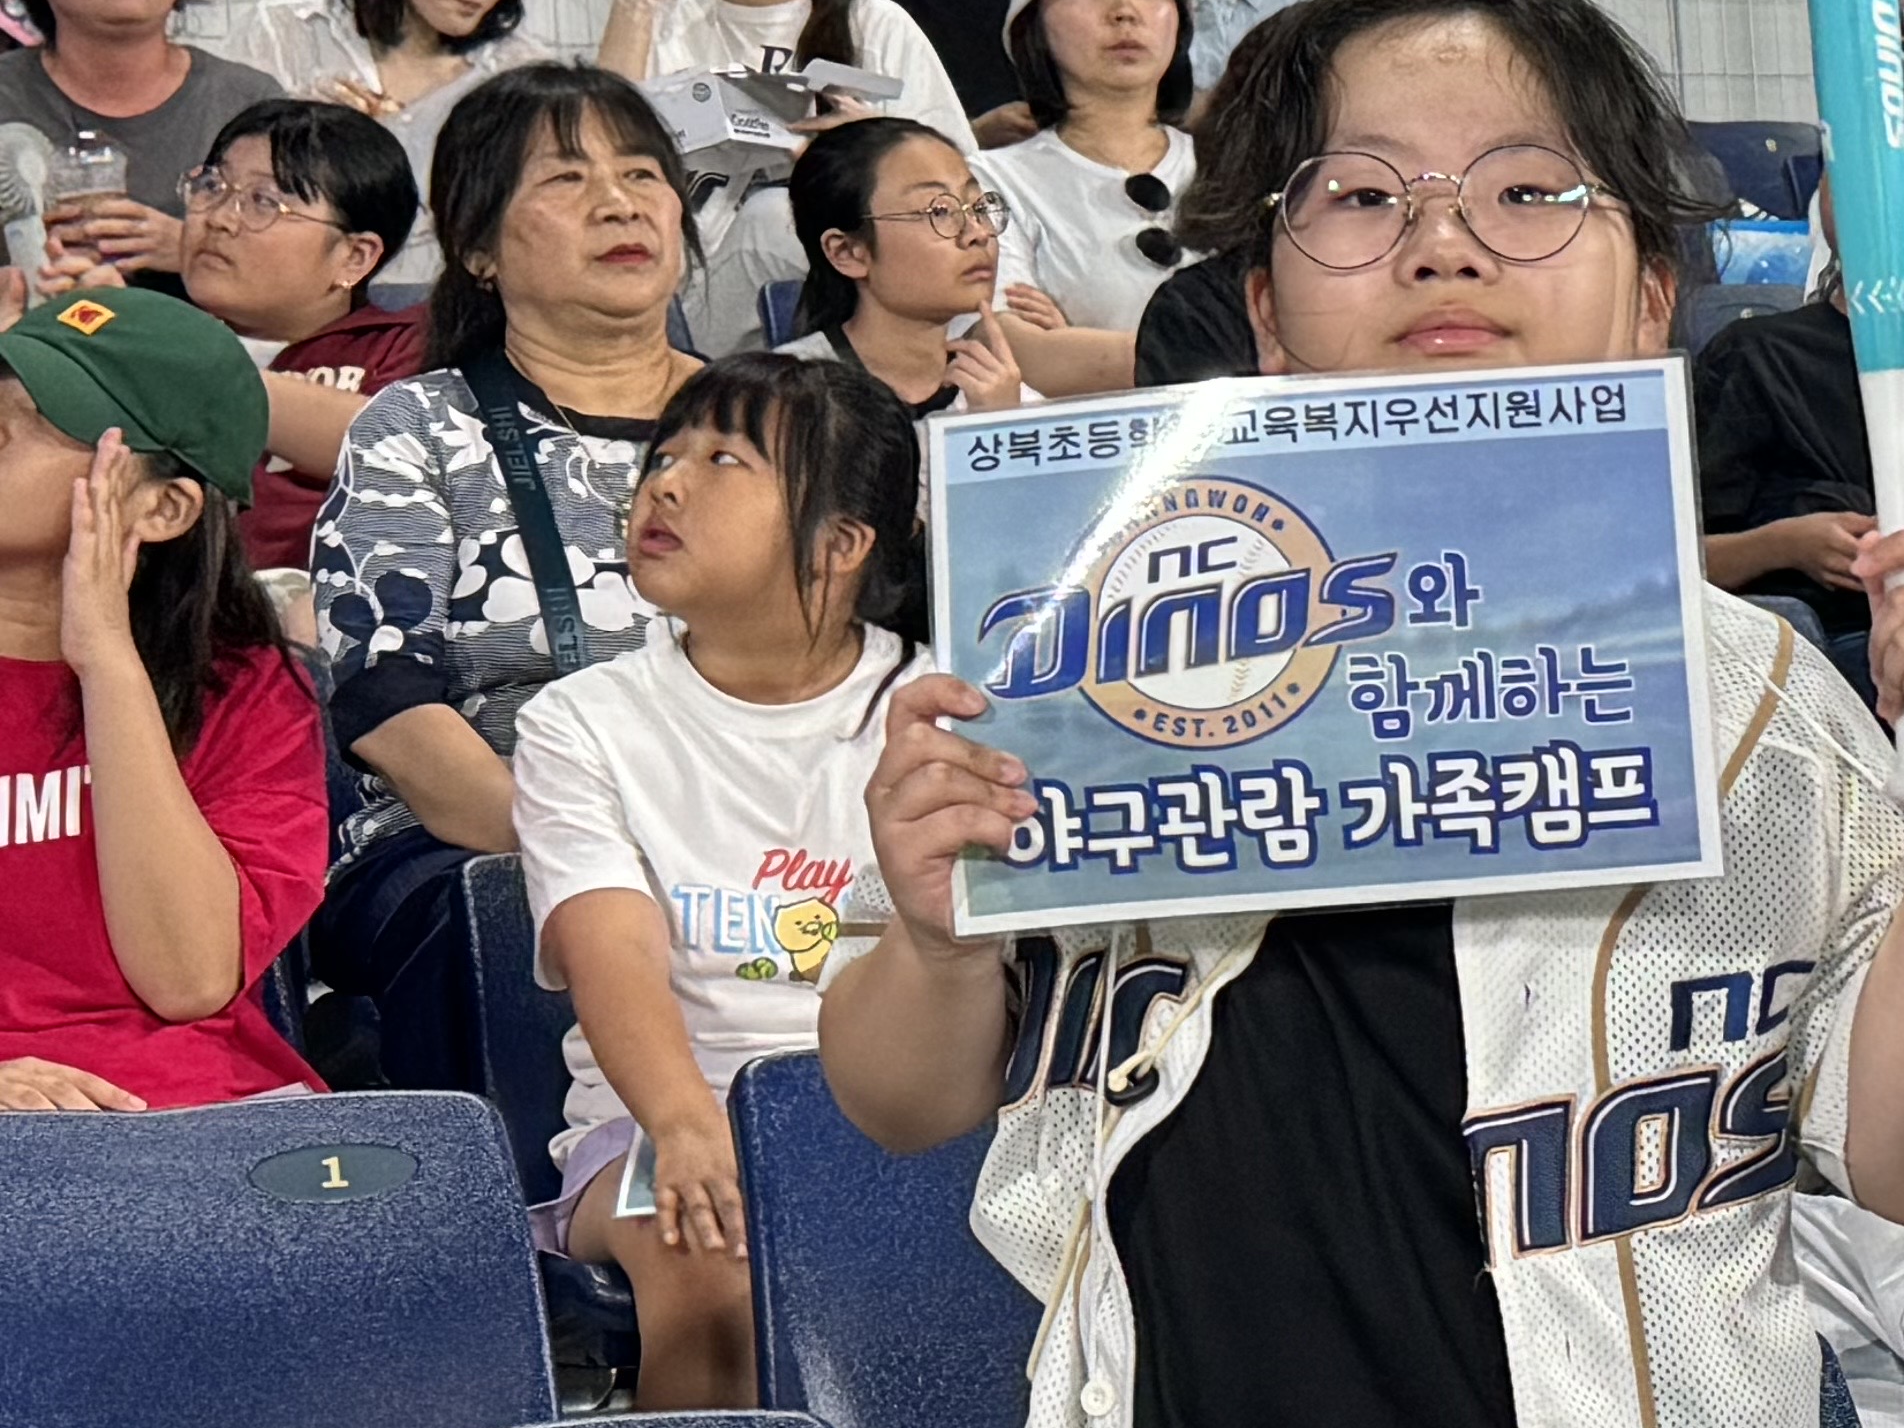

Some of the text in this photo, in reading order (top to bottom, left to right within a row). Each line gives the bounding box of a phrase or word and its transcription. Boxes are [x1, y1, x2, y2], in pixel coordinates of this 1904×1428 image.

[967, 382, 1627, 473] 상북초등 교육복지우선지원사업
[1407, 550, 1482, 629] 와
[1151, 691, 1290, 739] EST. 2011
[1347, 645, 1634, 741] 함께하는
[1007, 740, 1659, 873] 야구관람 가족캠프
[751, 848, 855, 904] Play
[671, 883, 790, 956] TEN
[320, 1156, 349, 1189] 1
